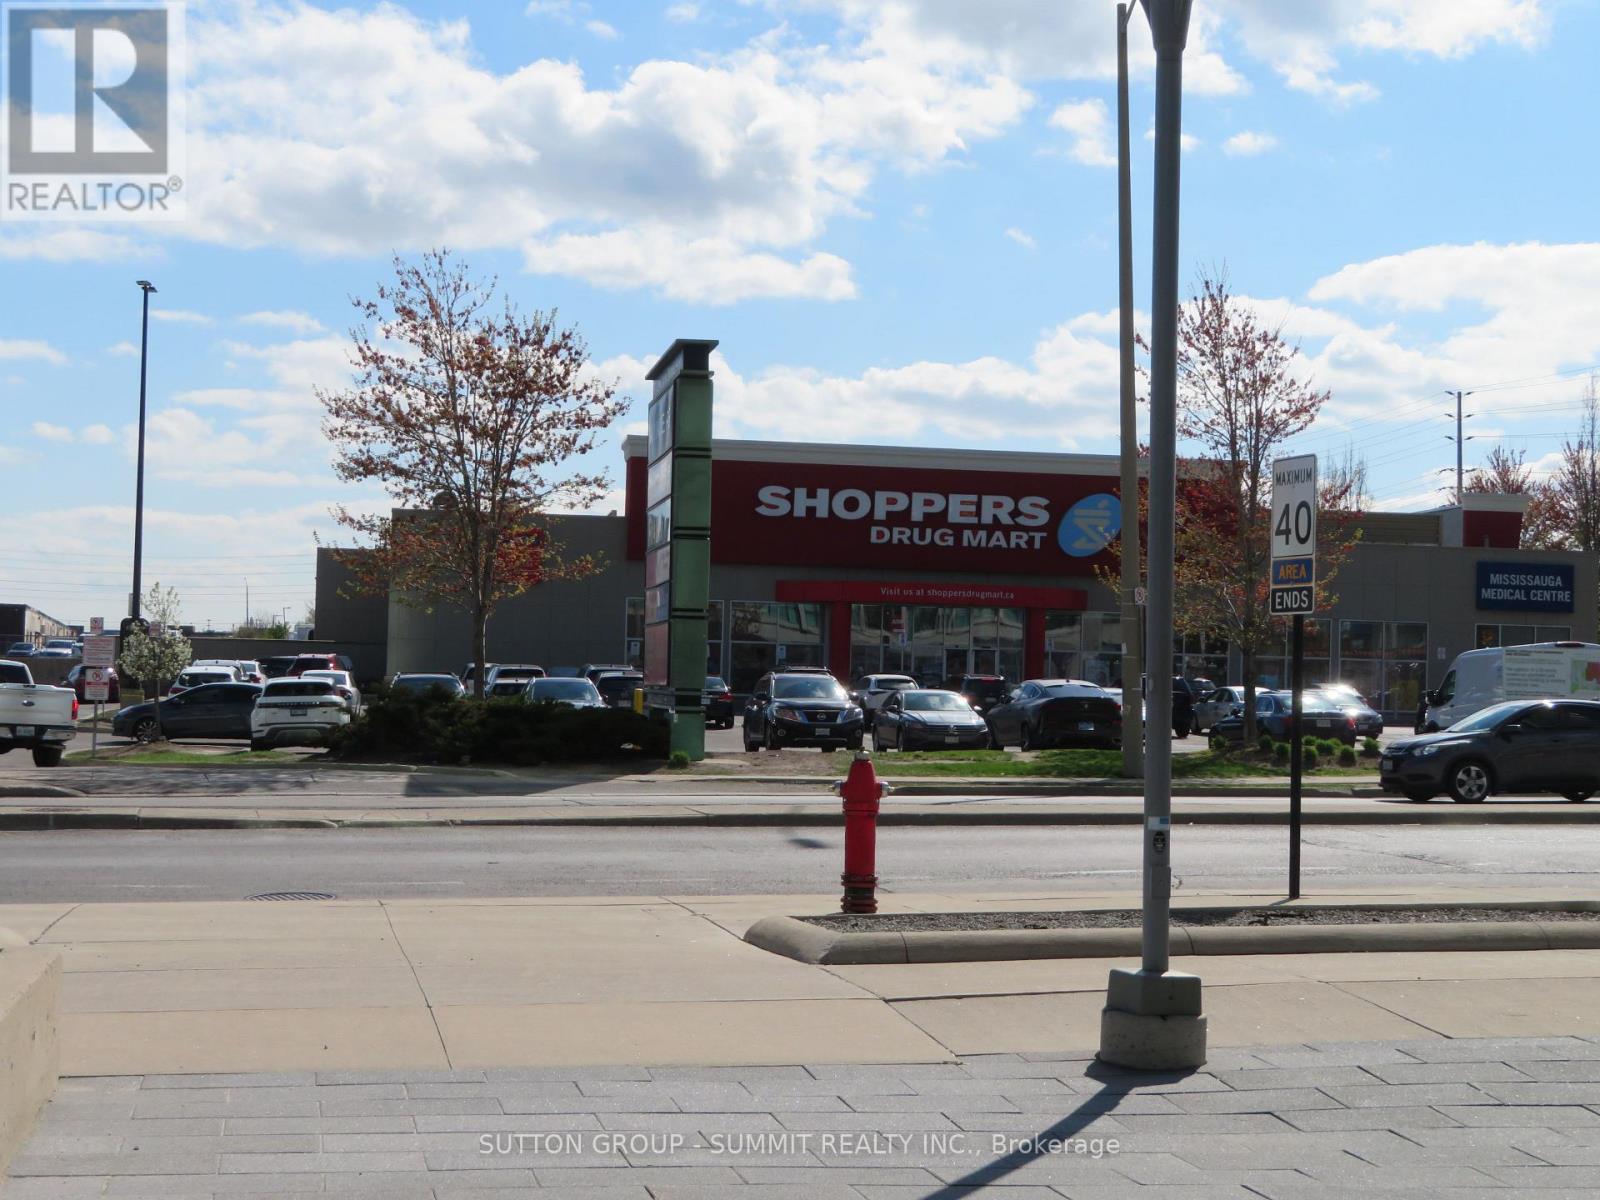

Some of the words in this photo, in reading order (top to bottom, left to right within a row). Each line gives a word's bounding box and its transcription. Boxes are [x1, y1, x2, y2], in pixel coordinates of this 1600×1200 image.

[1275, 467, 1312, 486] MAXIMUM
[755, 485, 1050, 526] SHOPPERS
[1275, 500, 1311, 545] 40
[870, 526, 954, 547] DRUG
[962, 529, 1048, 550] MART
[1279, 565, 1307, 579] AREA
[1489, 574, 1562, 587] MISSISSAUGA
[880, 586, 901, 596] Visit
[903, 588, 914, 596] us
[915, 588, 925, 596] at
[927, 588, 1015, 599] shoppersdrugmart.ca
[1275, 590, 1309, 609] ENDS
[1481, 588, 1527, 600] MEDICAL
[1530, 590, 1571, 602] CENTRE
